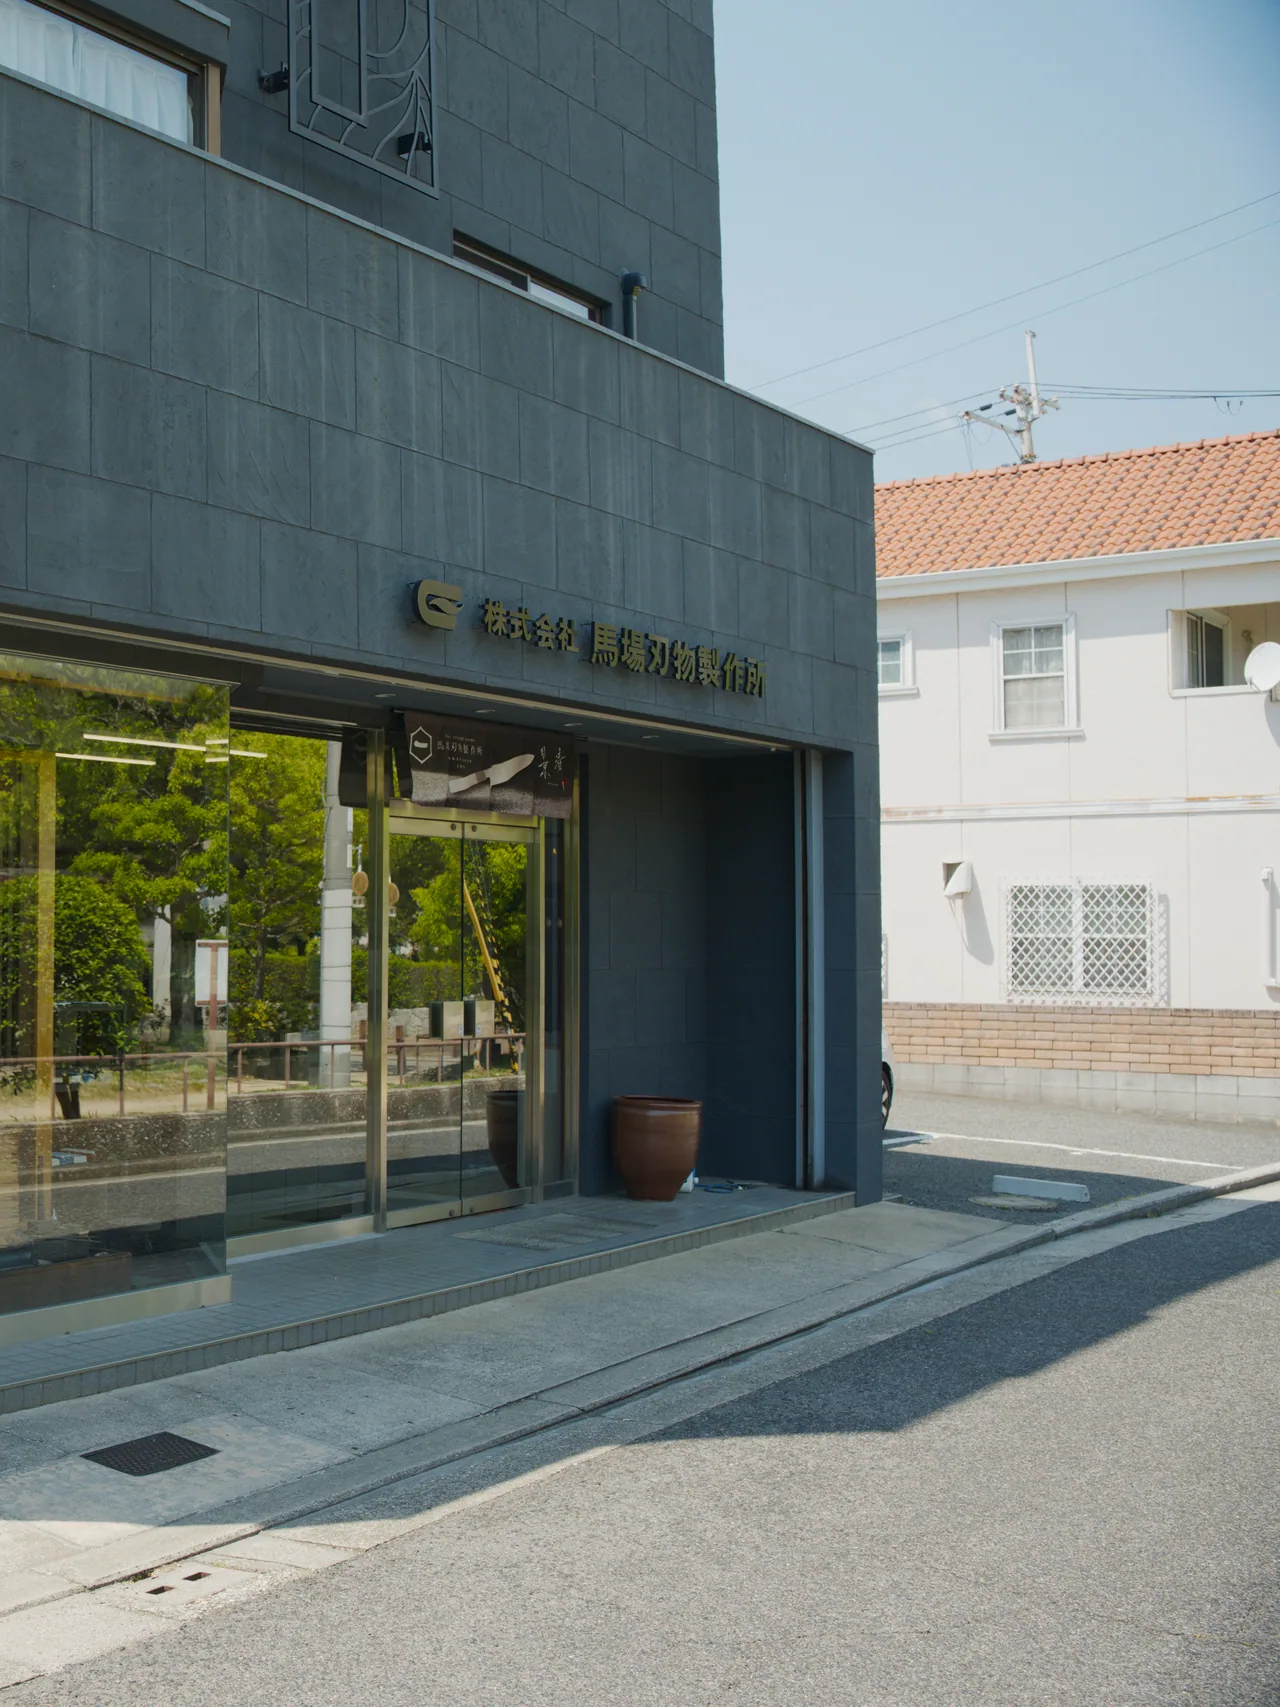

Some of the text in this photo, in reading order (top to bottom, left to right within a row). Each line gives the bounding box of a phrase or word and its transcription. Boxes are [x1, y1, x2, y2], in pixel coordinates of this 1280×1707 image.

[483, 598, 767, 698] 株式会社 馬場刃物製作所
